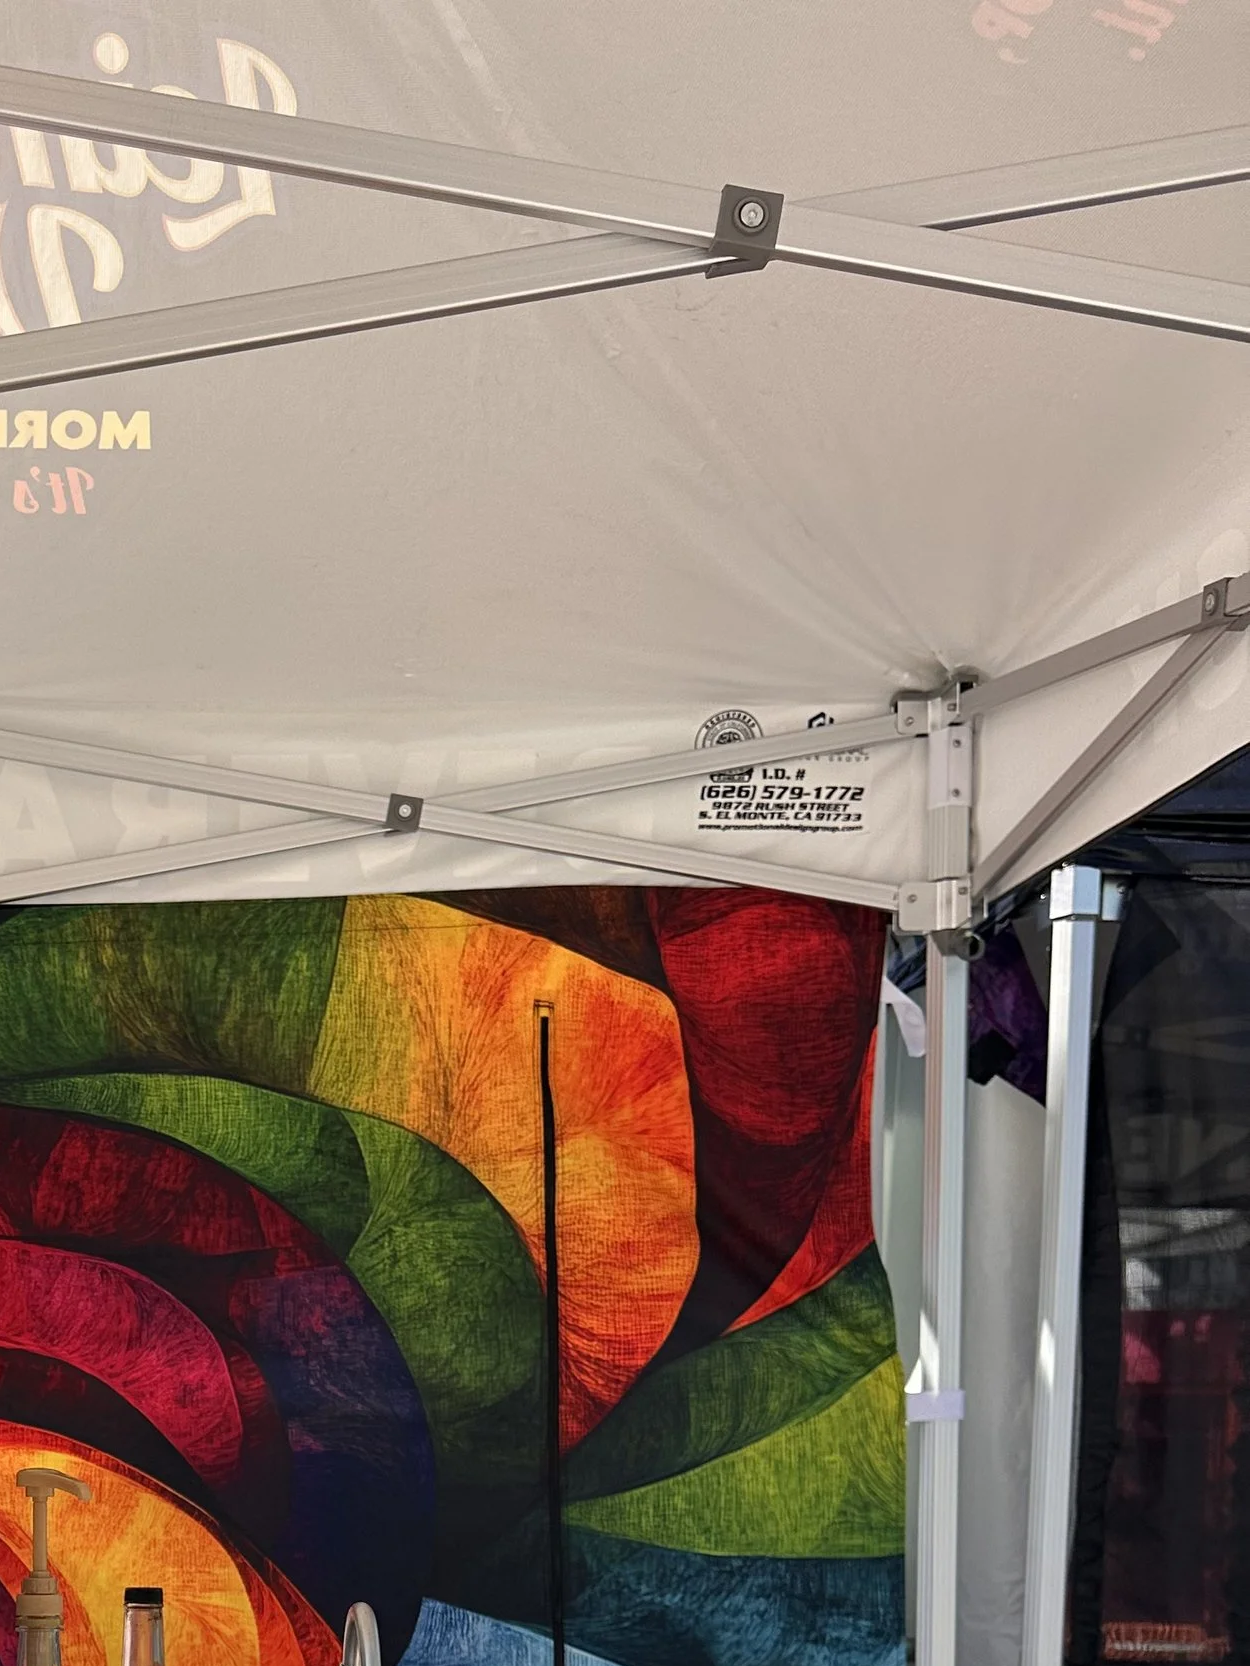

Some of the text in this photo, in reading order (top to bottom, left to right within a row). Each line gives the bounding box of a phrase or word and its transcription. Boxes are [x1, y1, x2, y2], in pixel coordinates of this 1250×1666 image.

[762, 768, 790, 780] I.D.
[795, 768, 806, 780] #
[700, 785, 865, 801] (626) 579-1772
[711, 801, 850, 813] 9872 RUSH STREET
[716, 811, 732, 821] EL
[793, 812, 813, 822] CA
[815, 812, 862, 823] 91733
